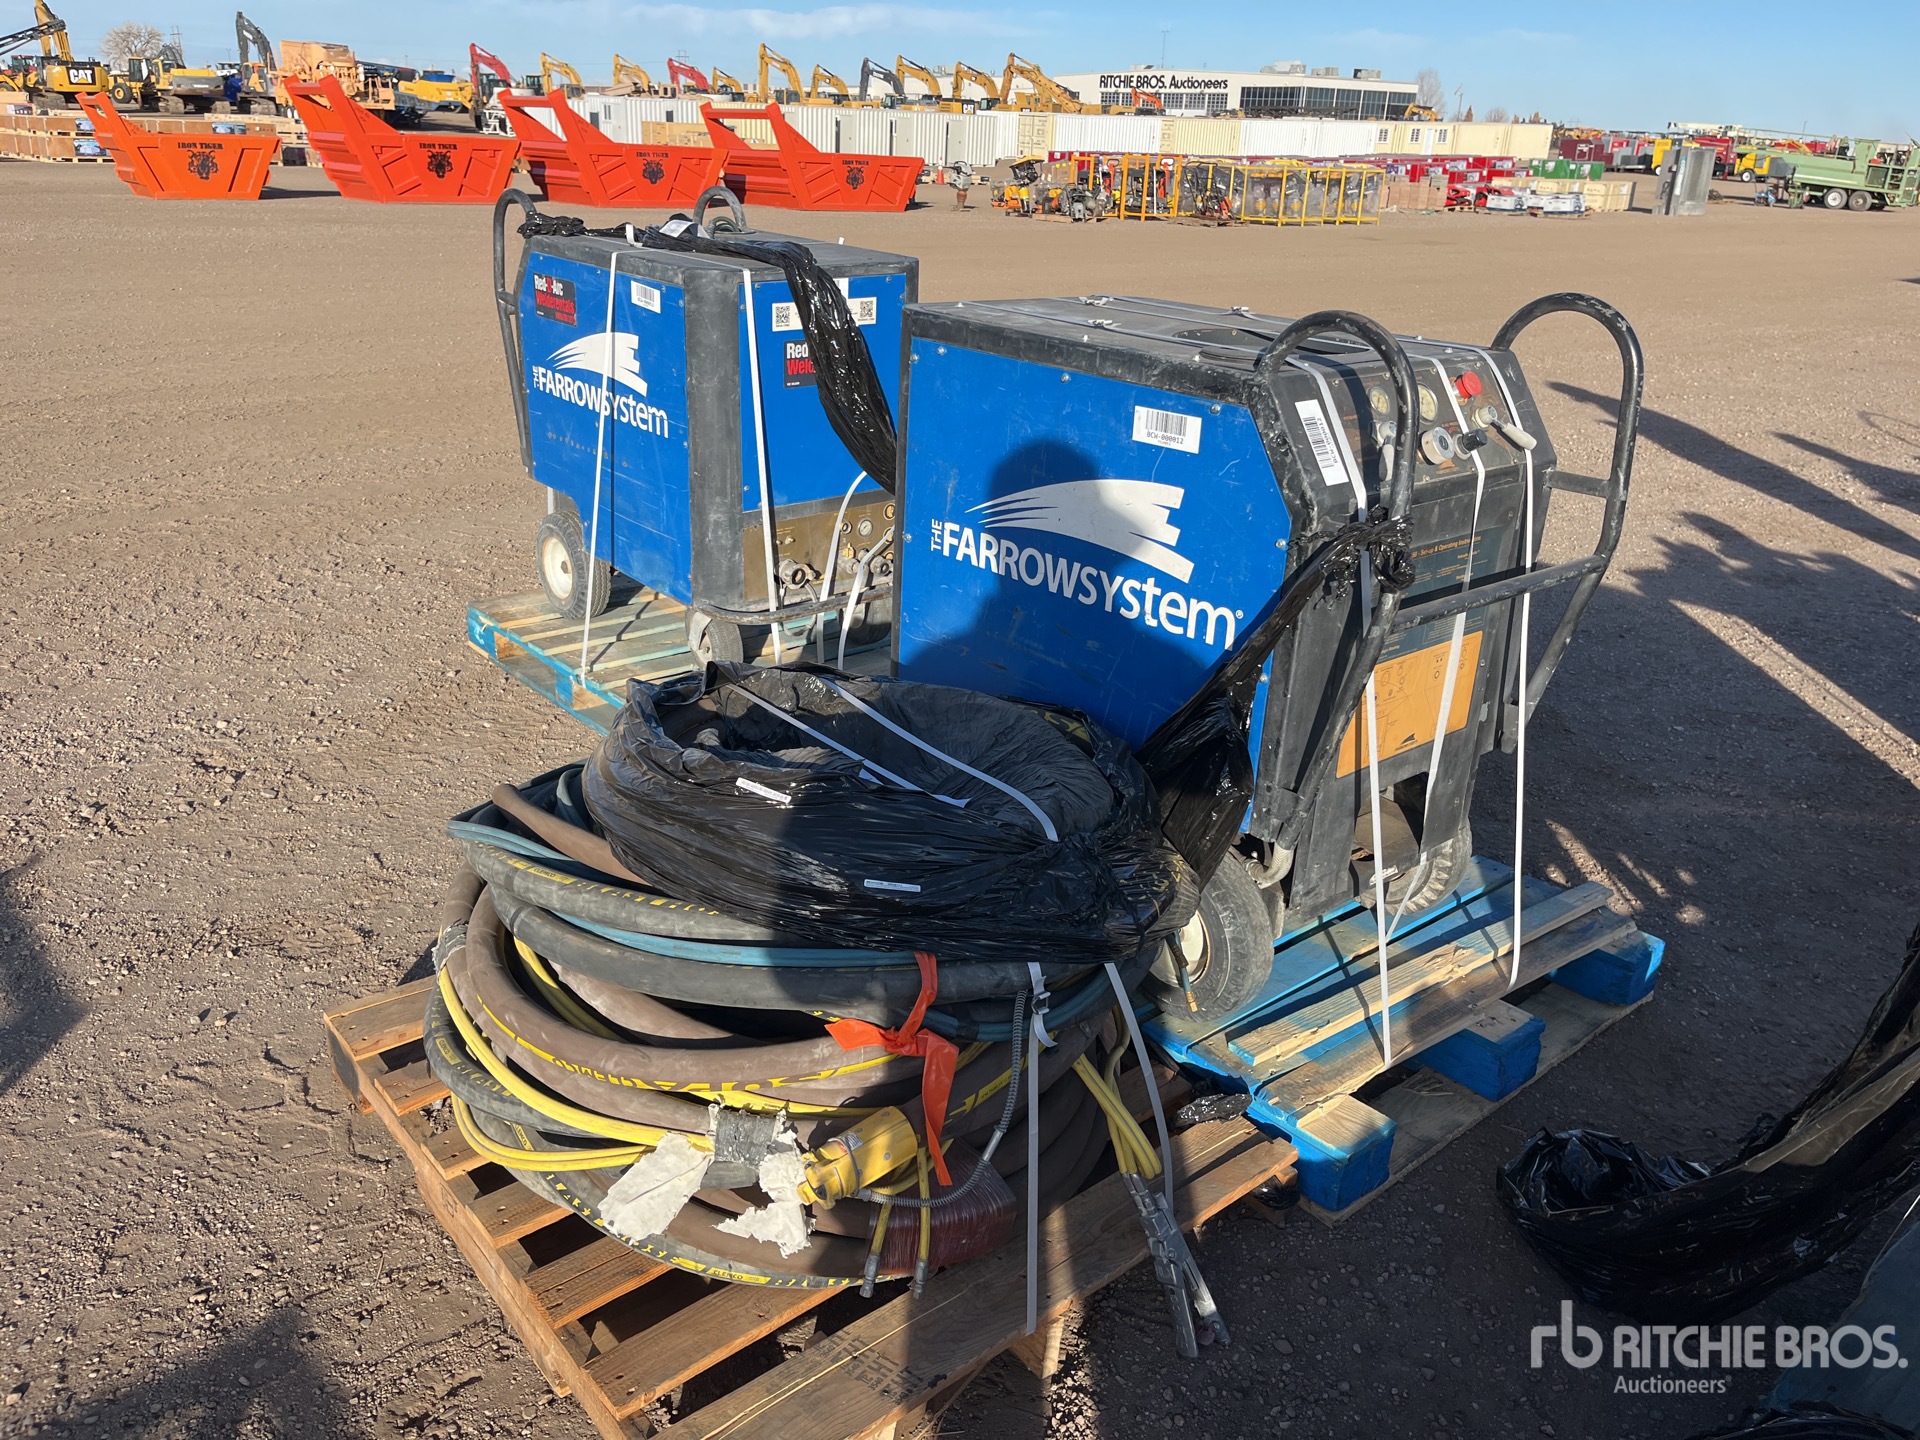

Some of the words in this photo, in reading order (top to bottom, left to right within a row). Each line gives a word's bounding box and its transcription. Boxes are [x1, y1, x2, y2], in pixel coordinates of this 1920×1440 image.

[69, 69, 92, 84] CAT
[1099, 75, 1134, 88] RITCHIE
[1135, 75, 1167, 89] BROS.
[1168, 74, 1228, 89] Auctioneers
[961, 103, 974, 114] CAT
[786, 342, 808, 359] Red
[532, 365, 540, 388] THE
[931, 518, 943, 551] THE
[713, 1269, 743, 1281] CLEMCO
[867, 1352, 899, 1378] HT
